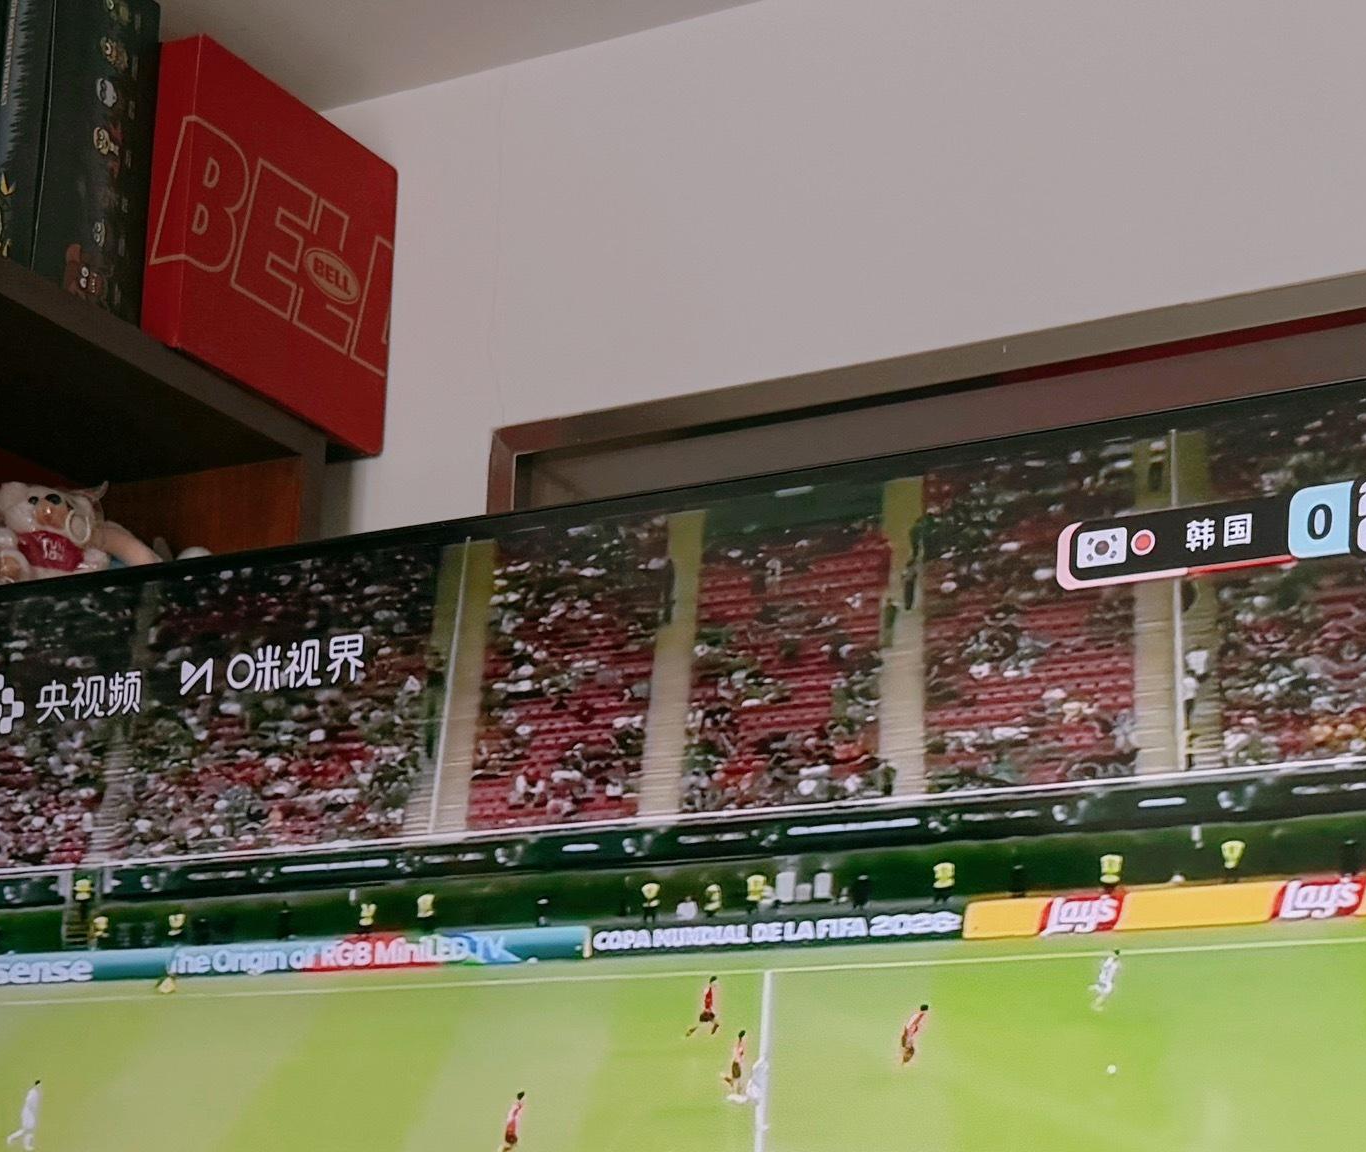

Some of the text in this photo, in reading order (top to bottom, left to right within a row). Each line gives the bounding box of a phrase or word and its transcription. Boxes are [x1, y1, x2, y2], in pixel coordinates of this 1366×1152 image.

[314, 256, 351, 296] BELL
[1185, 513, 1253, 553] 韩国
[1306, 503, 1334, 541] 0
[36, 671, 143, 724] 央视频
[1040, 894, 1122, 937] Lay's
[1277, 878, 1360, 920] Lay's
[593, 911, 963, 951] COPA MUNDIAL DE LA FIFA 2026
[212, 945, 287, 976] Origin
[320, 941, 373, 968] RGB
